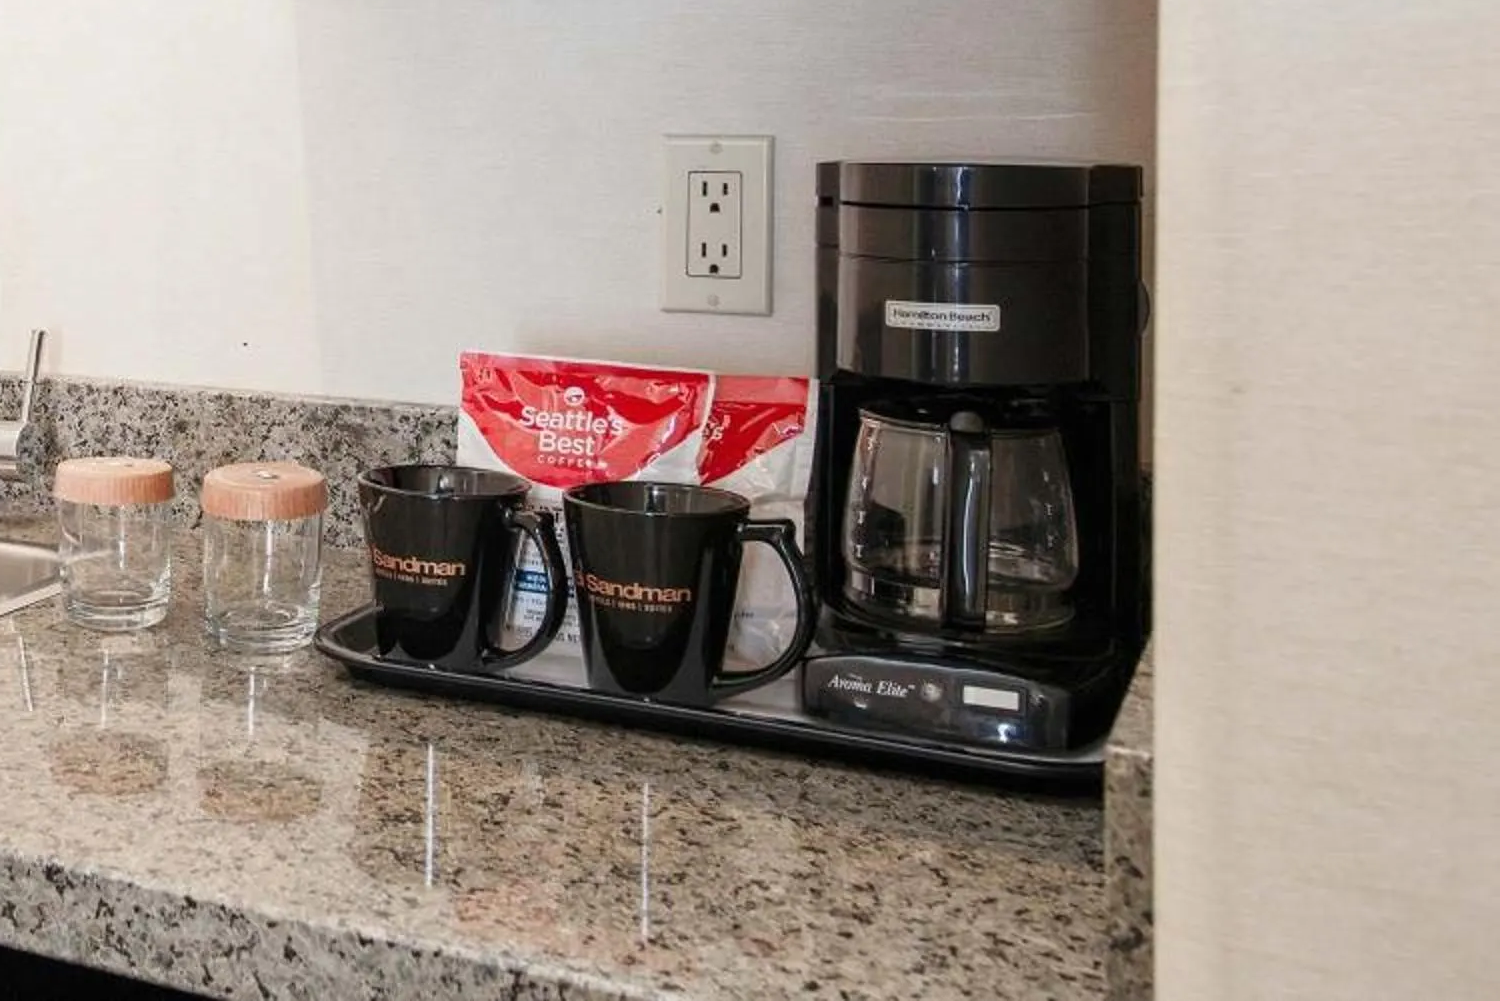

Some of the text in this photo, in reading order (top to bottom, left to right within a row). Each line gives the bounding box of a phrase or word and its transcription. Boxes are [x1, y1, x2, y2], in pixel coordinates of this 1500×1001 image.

[519, 406, 624, 436] Seattle's
[538, 430, 595, 457] Best
[373, 546, 467, 576] Sandman
[586, 574, 692, 602] Sandman
[827, 673, 873, 694] Aroma
